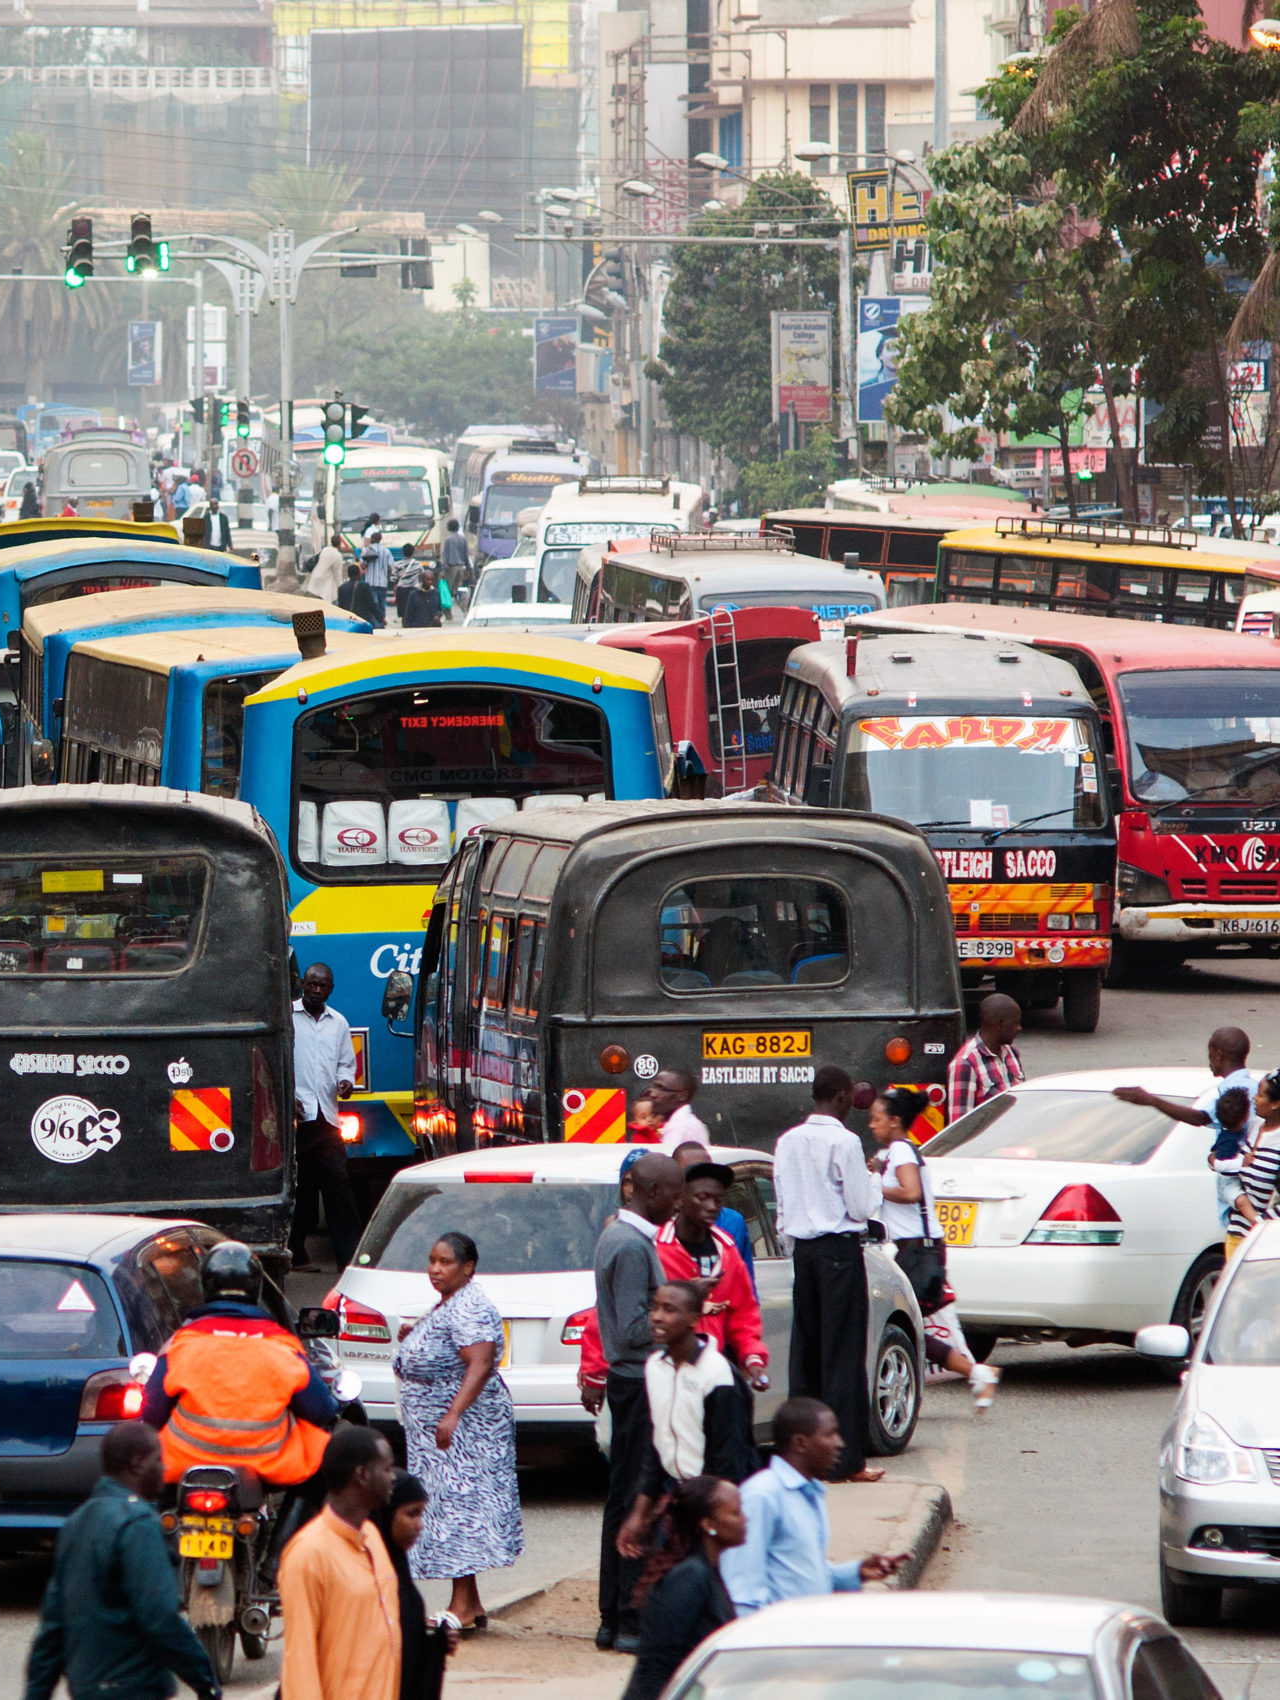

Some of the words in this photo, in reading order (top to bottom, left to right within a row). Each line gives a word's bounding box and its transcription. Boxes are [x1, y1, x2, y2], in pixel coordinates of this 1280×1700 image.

[867, 224, 928, 241] DRIVING
[811, 604, 873, 619] METRO
[1195, 845, 1239, 864] KMO
[1004, 850, 1057, 879] SACCO
[1222, 920, 1250, 932] KBJ
[976, 941, 1014, 956] 829B
[705, 1035, 745, 1055] KAG
[756, 1034, 809, 1054] 882J
[926, 1045, 943, 1053] PSV
[76, 1054, 130, 1077] SACCO
[637, 1055, 655, 1070] 80
[702, 1066, 760, 1084] EASTLEIGH
[763, 1066, 778, 1084] RT
[780, 1065, 815, 1084] SACCO
